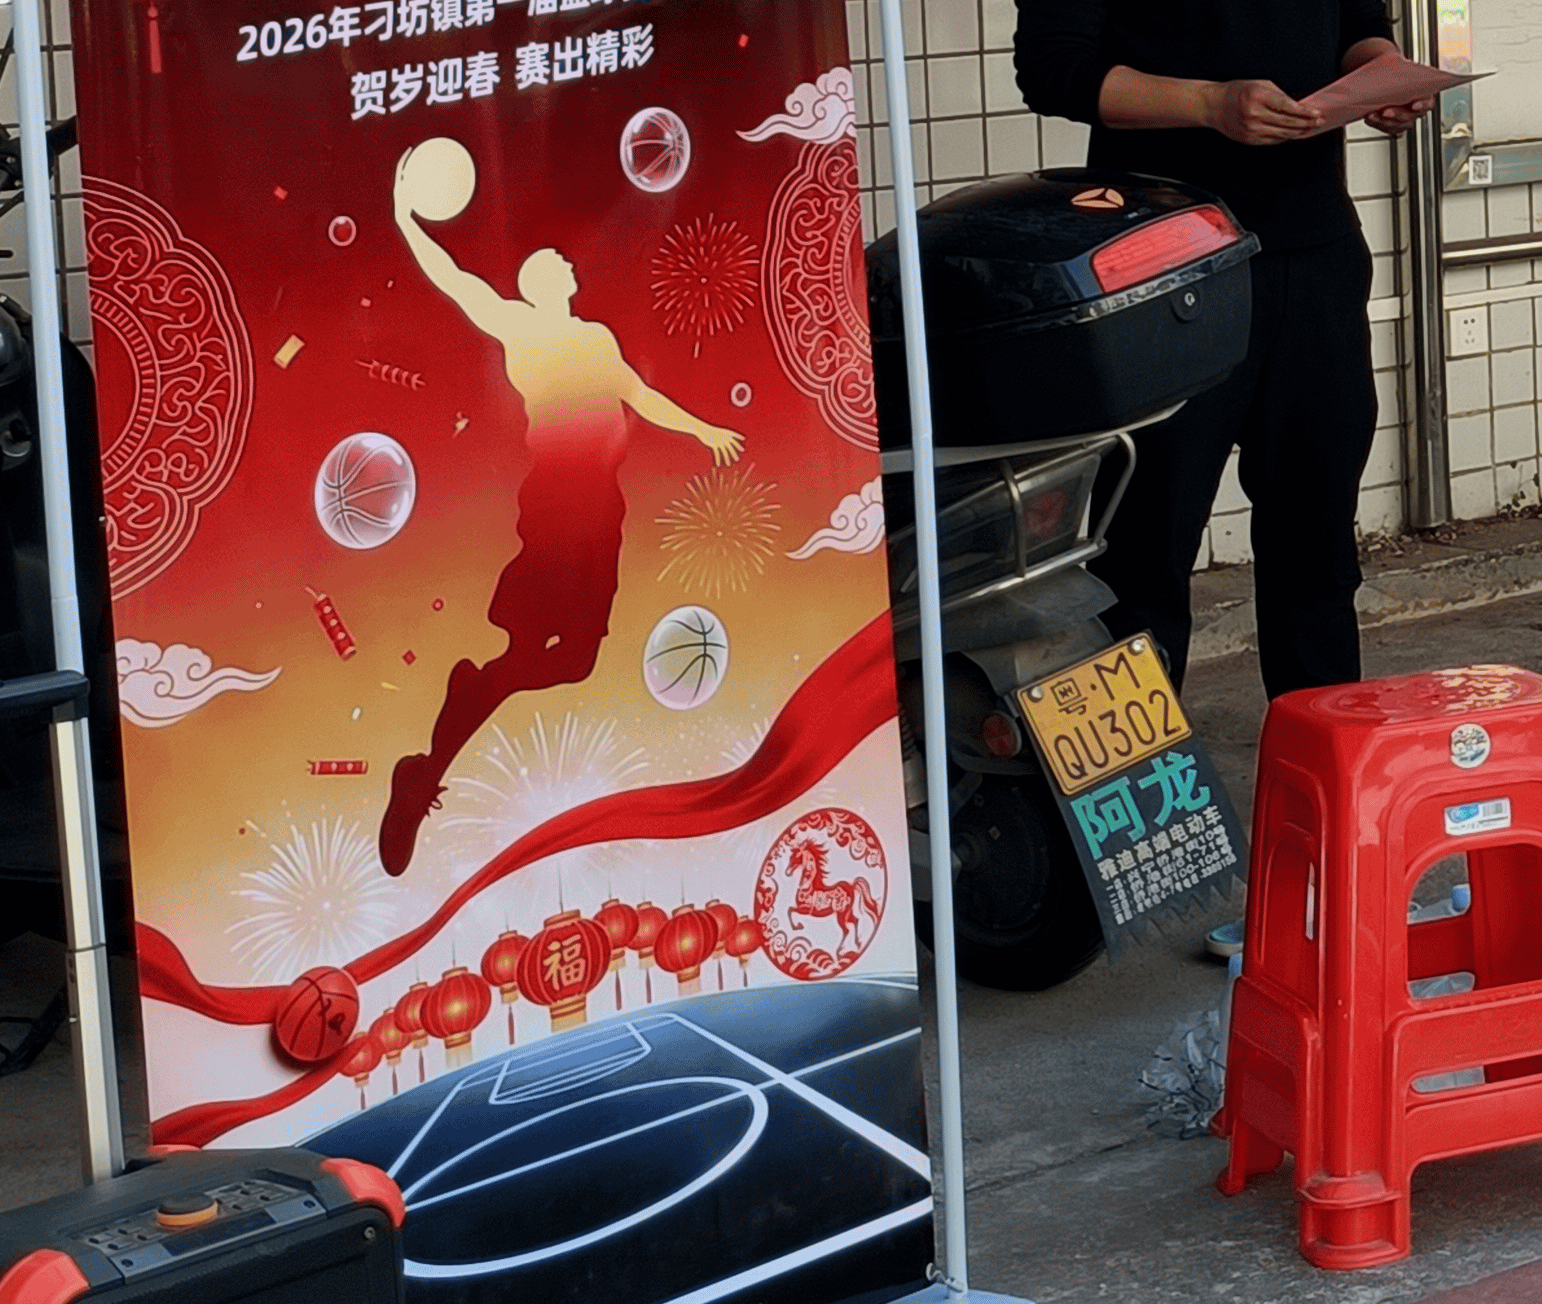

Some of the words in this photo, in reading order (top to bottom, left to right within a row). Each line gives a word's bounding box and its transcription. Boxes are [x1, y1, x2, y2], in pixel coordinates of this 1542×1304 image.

[350, 51, 500, 121] 贺岁迎春
[514, 23, 656, 91] 赛出精彩
[1053, 688, 1182, 780] QU302
[1070, 751, 1211, 861] 阿龙
[1097, 804, 1222, 881] 雅迪高端电动车
[542, 933, 587, 991] 福
